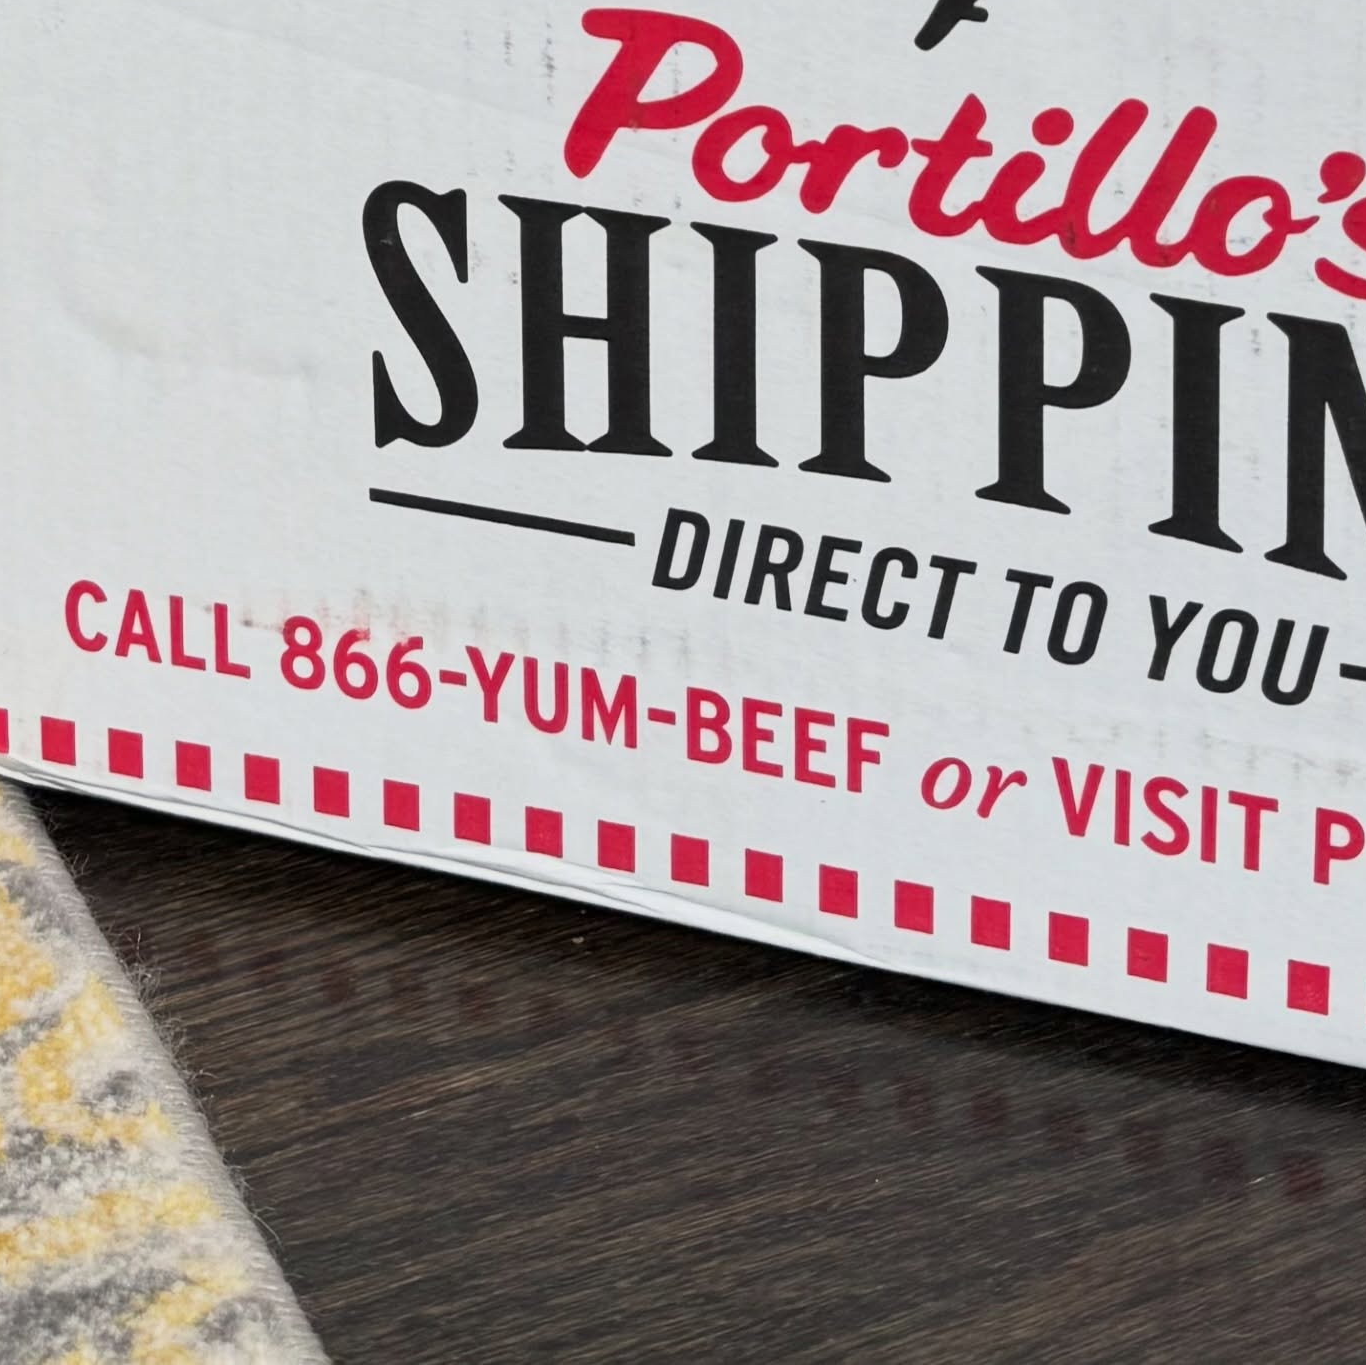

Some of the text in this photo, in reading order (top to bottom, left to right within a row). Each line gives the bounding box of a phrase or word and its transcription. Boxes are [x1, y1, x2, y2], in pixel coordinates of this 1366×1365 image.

[64, 580, 250, 679] CALL
[280, 616, 889, 793] 866-YUM-BEEF
[921, 756, 1028, 820] or
[1052, 757, 1278, 871] VISIT
[652, 507, 1330, 706] DIRECT TO YOU
